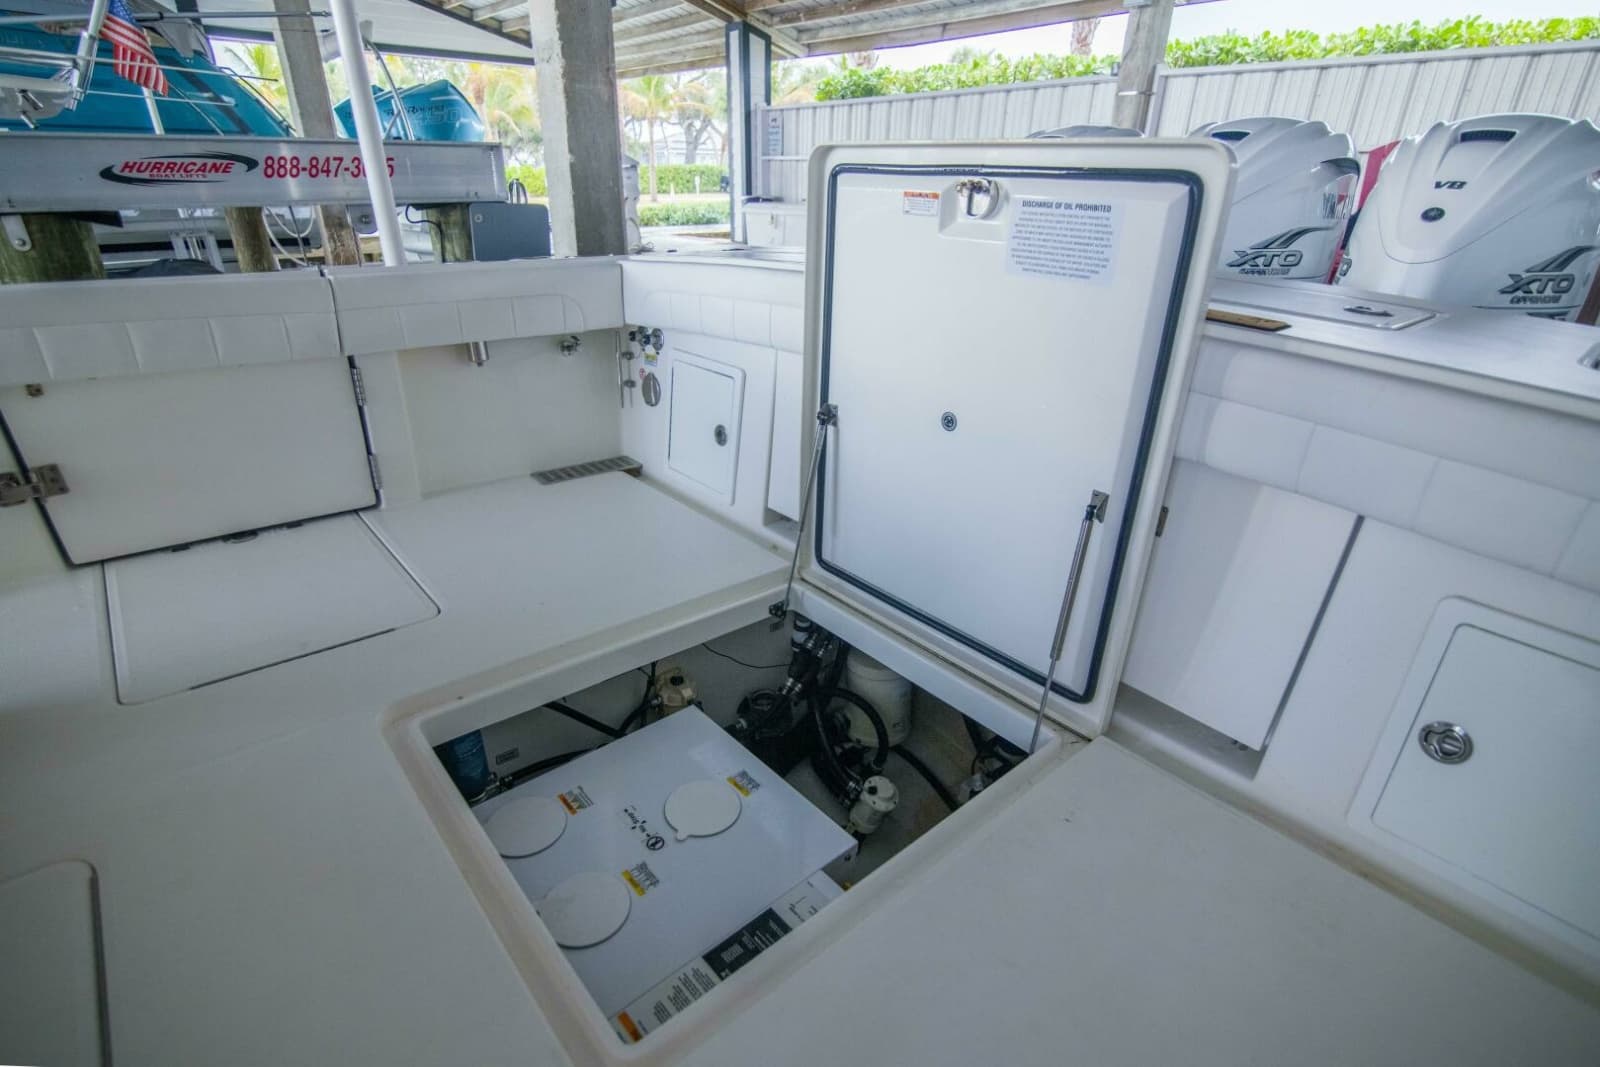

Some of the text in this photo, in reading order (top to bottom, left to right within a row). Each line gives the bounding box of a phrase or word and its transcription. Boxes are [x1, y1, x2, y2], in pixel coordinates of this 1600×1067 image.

[120, 161, 236, 174] HURRICANE
[263, 155, 395, 178] 888-847-35
[1434, 181, 1467, 190] V8
[1022, 200, 1112, 213] DISCHARGE OF OIL PROHIBITED
[1226, 250, 1303, 267] XTO
[1498, 273, 1575, 294] XTO
